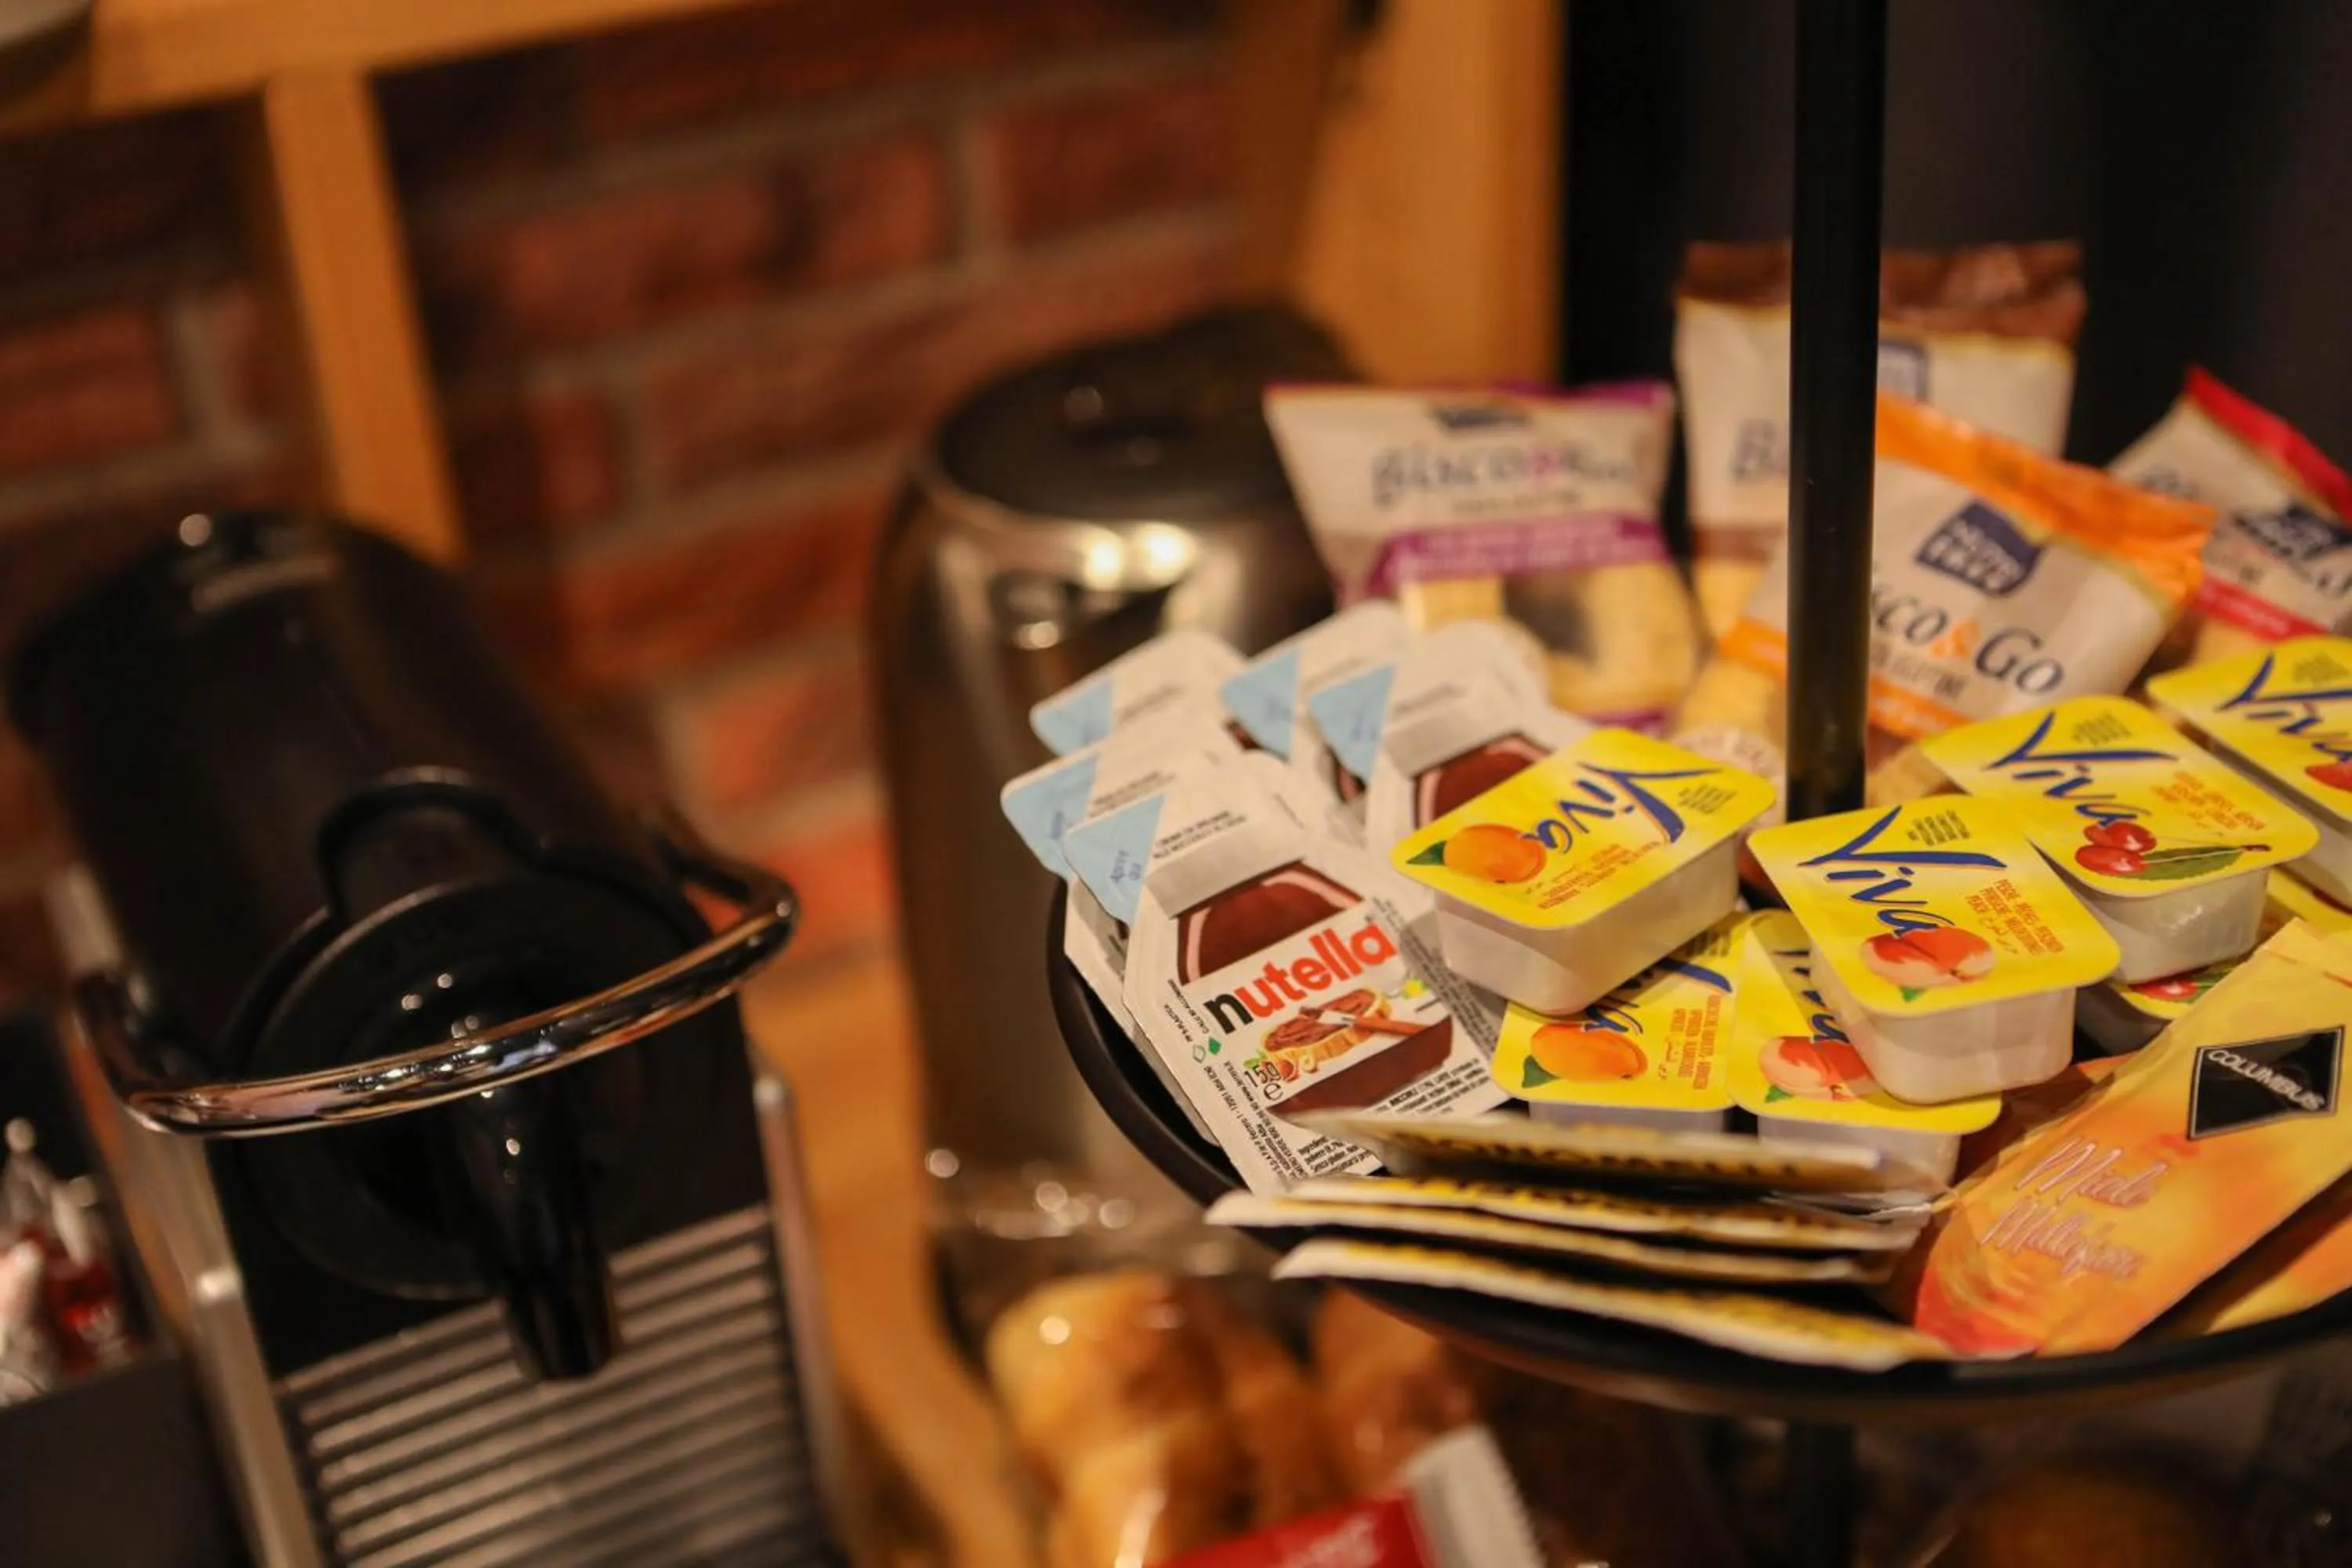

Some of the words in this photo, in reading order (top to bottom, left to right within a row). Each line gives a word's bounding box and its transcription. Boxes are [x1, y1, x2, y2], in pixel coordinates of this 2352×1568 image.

[1519, 760, 1726, 855] Viva
[1981, 710, 2178, 827] Viva
[1796, 805, 2008, 940] Viva
[1203, 923, 1398, 1035] nutella
[2207, 1049, 2325, 1112] COLUMBUS
